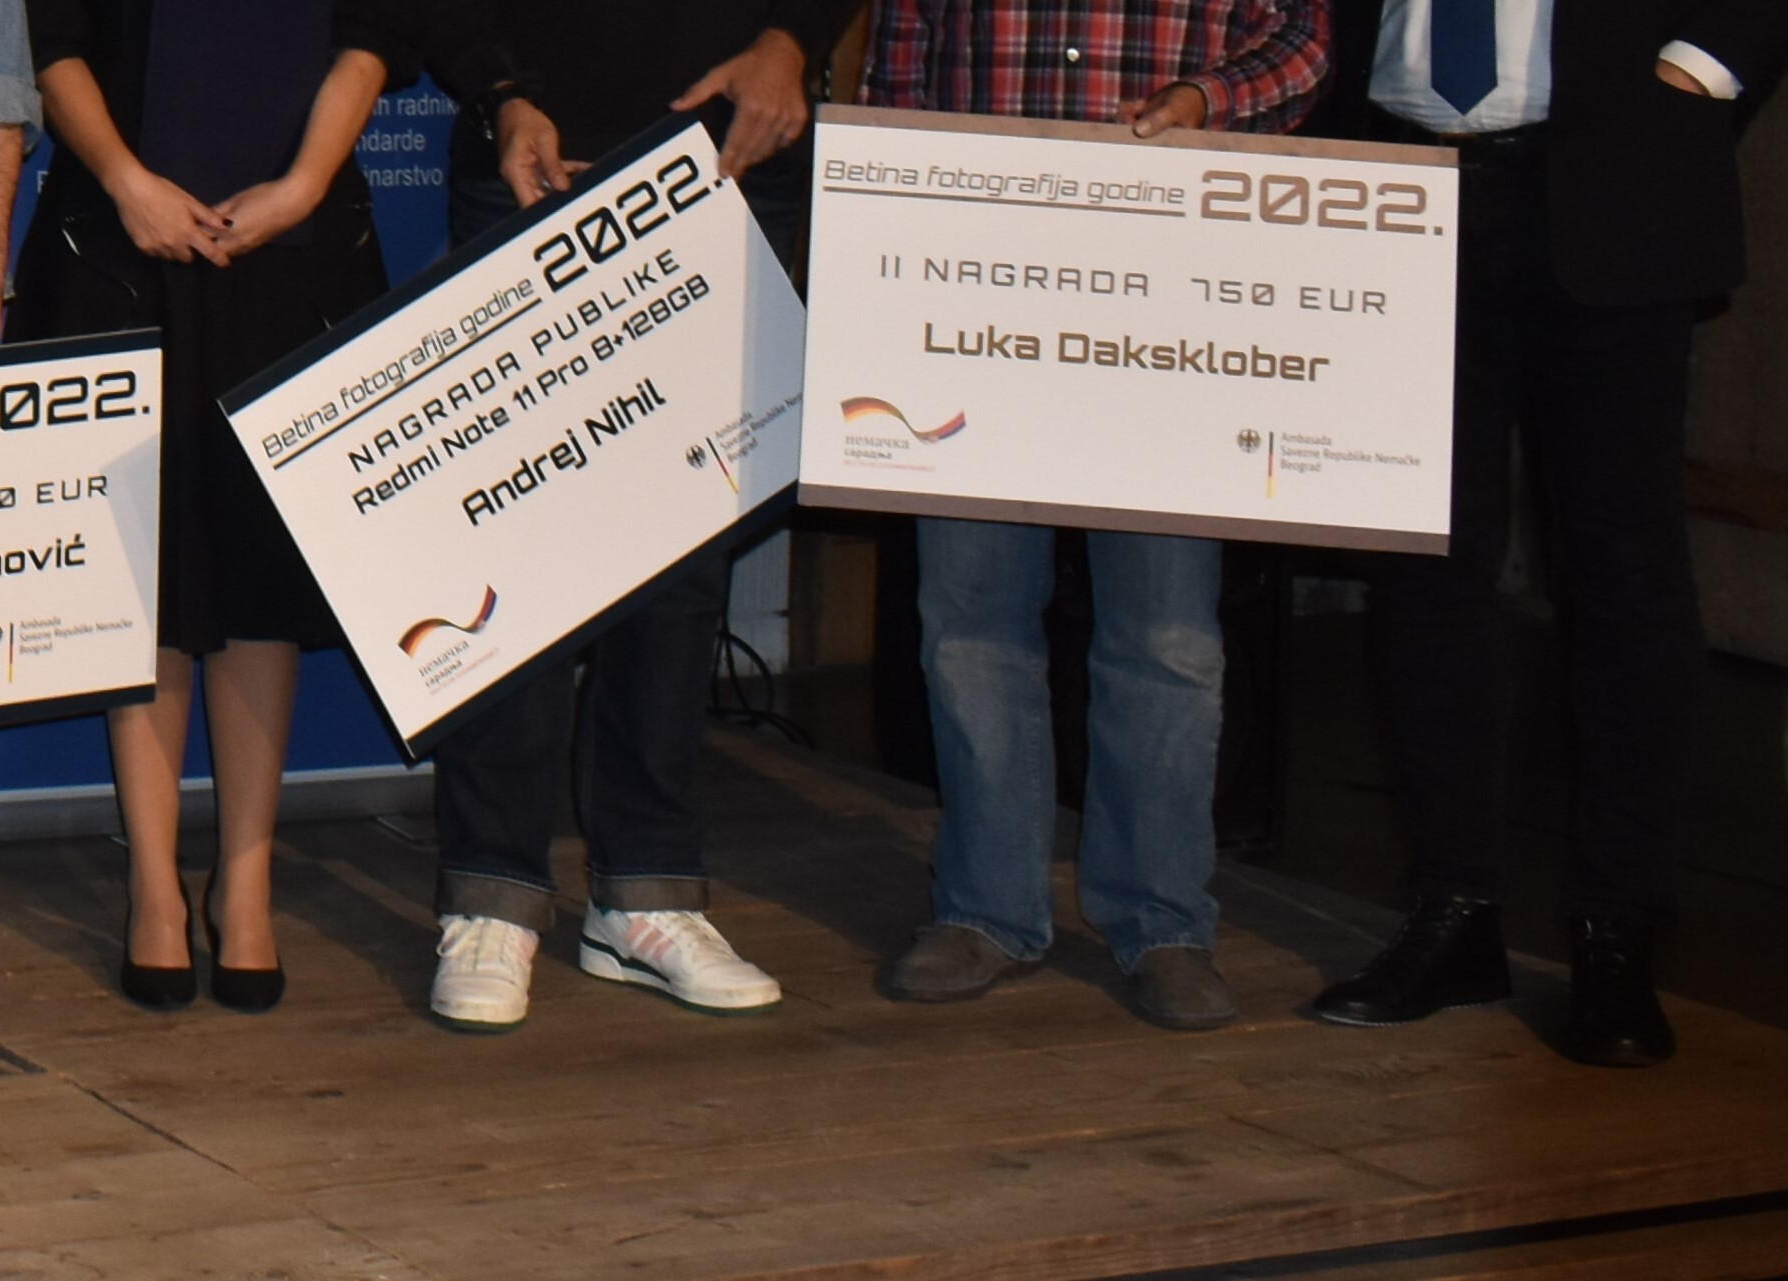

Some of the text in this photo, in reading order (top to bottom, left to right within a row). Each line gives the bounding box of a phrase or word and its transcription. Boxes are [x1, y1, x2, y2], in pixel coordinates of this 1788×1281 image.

[823, 158, 1445, 237] Betina fotografija godine 2022.
[261, 153, 724, 460] Betina fotografija godine 2022.
[880, 253, 1388, 316] II NAGRADA 750 EUR
[347, 249, 682, 474] NAGRADA PUBLIKE
[352, 444, 443, 515] Redmi
[441, 404, 512, 458] Note
[540, 353, 590, 400] Pro
[590, 272, 712, 362] 8+128GB
[923, 321, 1331, 383] Luka Daksklober
[35, 474, 109, 507] EUR
[461, 377, 667, 527] Andrej Nihil
